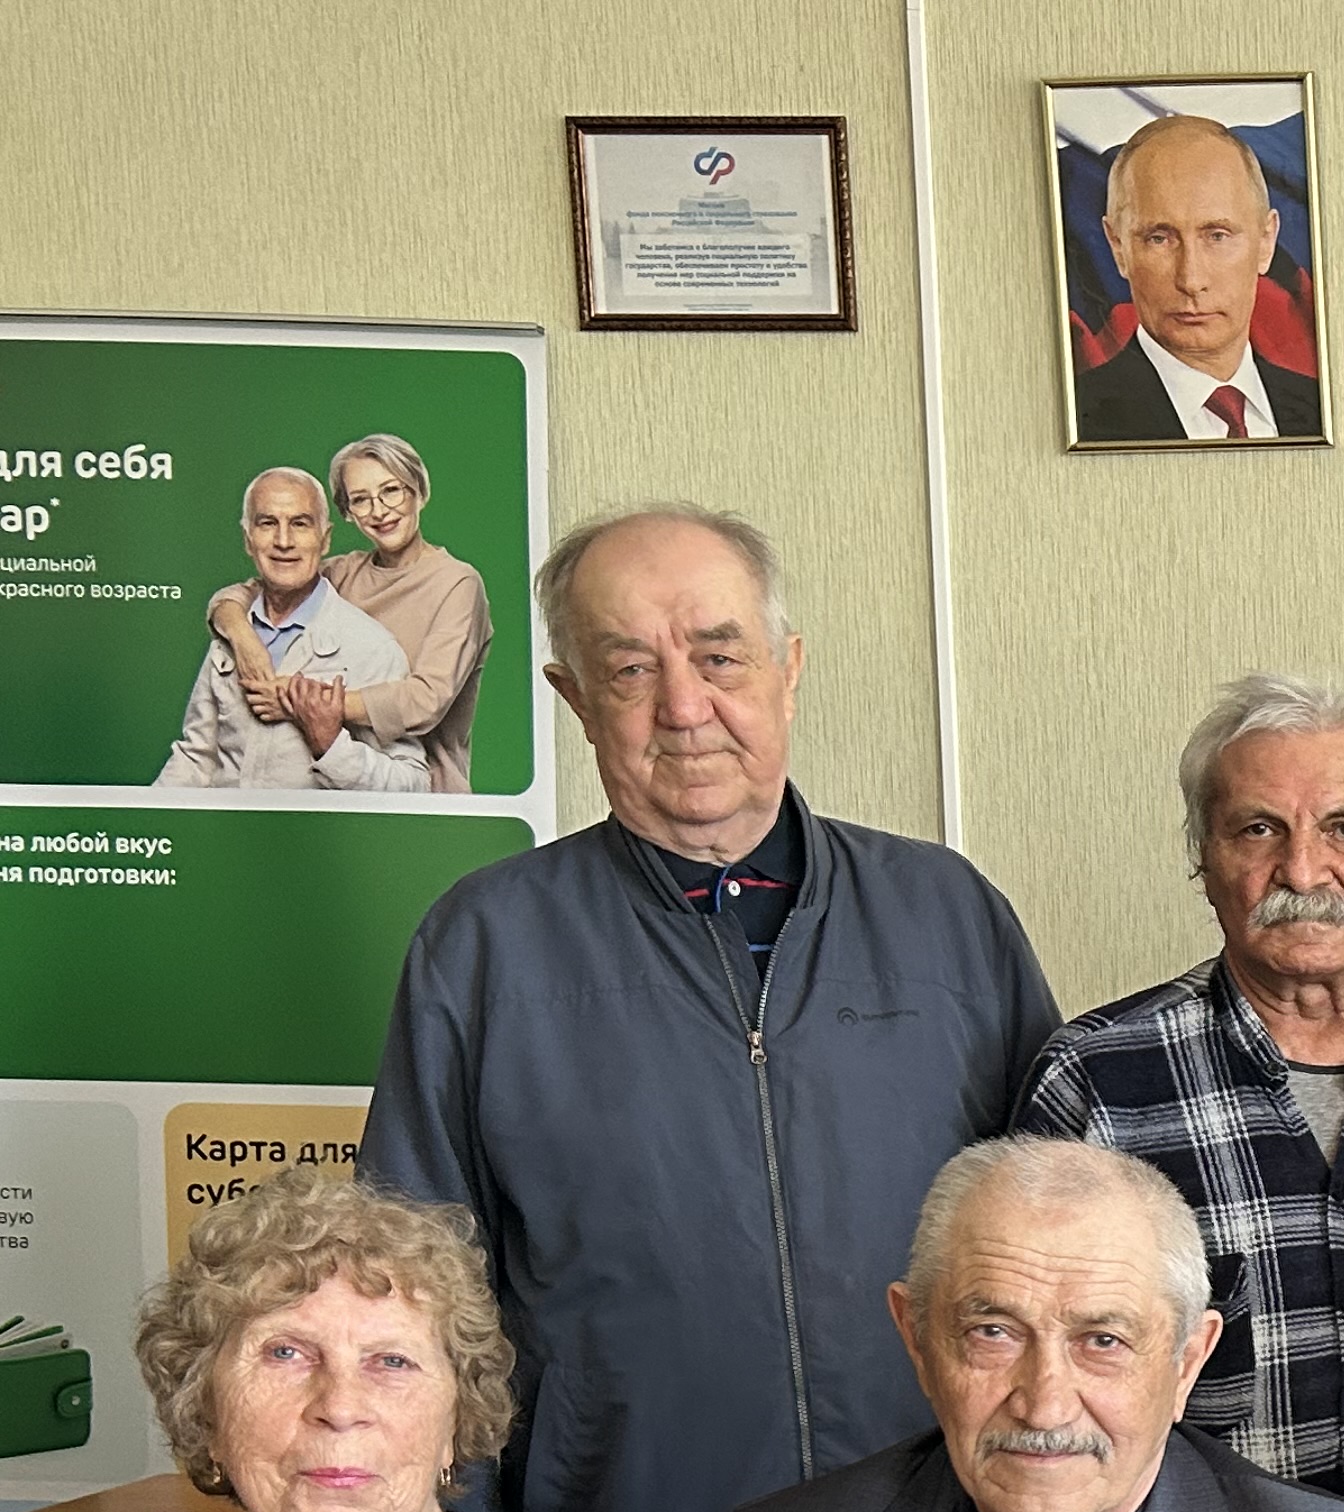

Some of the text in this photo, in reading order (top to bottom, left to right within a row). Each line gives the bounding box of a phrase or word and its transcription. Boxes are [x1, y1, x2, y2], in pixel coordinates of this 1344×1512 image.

[75, 444, 172, 480] себя
[91, 583, 182, 600] возраста
[31, 832, 109, 853] любой
[116, 837, 172, 858] вкус
[29, 867, 176, 886] подготовки:
[186, 1133, 358, 1167] Карта для
[0, 1187, 32, 1200] сти
[187, 1178, 260, 1206] суб
